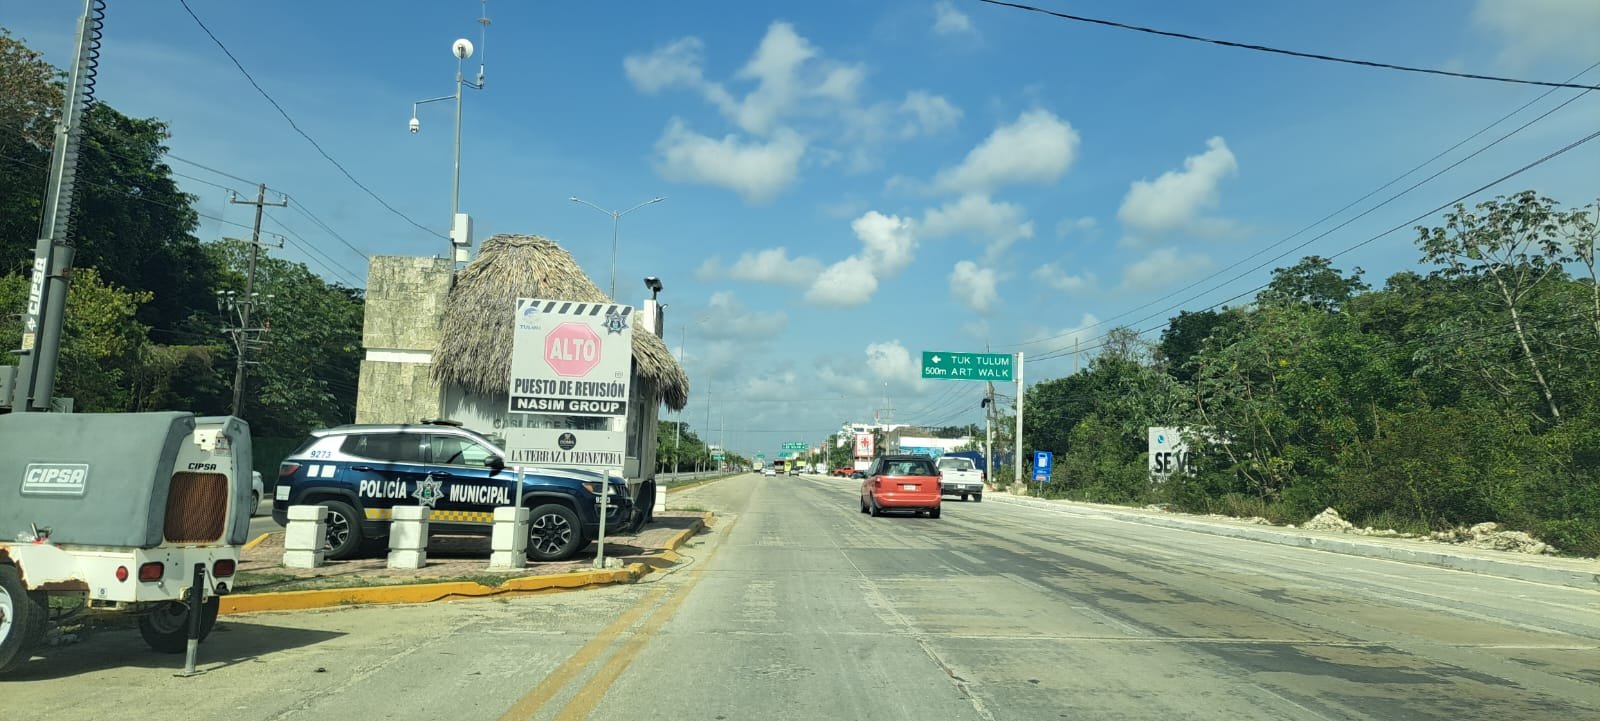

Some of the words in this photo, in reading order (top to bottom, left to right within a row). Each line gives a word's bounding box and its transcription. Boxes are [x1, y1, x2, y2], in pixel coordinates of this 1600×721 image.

[28, 257, 45, 315] CIPSA
[549, 337, 596, 362] ALTO
[951, 355, 971, 365] TUK
[976, 356, 1009, 366] TULUM
[925, 366, 947, 375] 500m
[951, 367, 973, 376] ART
[978, 368, 1009, 377] WALK
[514, 378, 557, 395] PUESTO
[559, 380, 573, 396] DE
[575, 380, 625, 398] REVISIÓN
[517, 398, 565, 410] NASIM
[569, 401, 620, 413] GROUP
[310, 450, 332, 458] 9273
[511, 449, 522, 462] LA
[525, 450, 566, 463] TERRAZA
[570, 451, 622, 464] FERNETERA
[188, 462, 217, 470] CIPSA
[1154, 452, 1172, 473] SE
[27, 468, 85, 483] CIPSA
[358, 477, 407, 499] POLICÍA
[449, 484, 510, 505] MUNICIPAL
